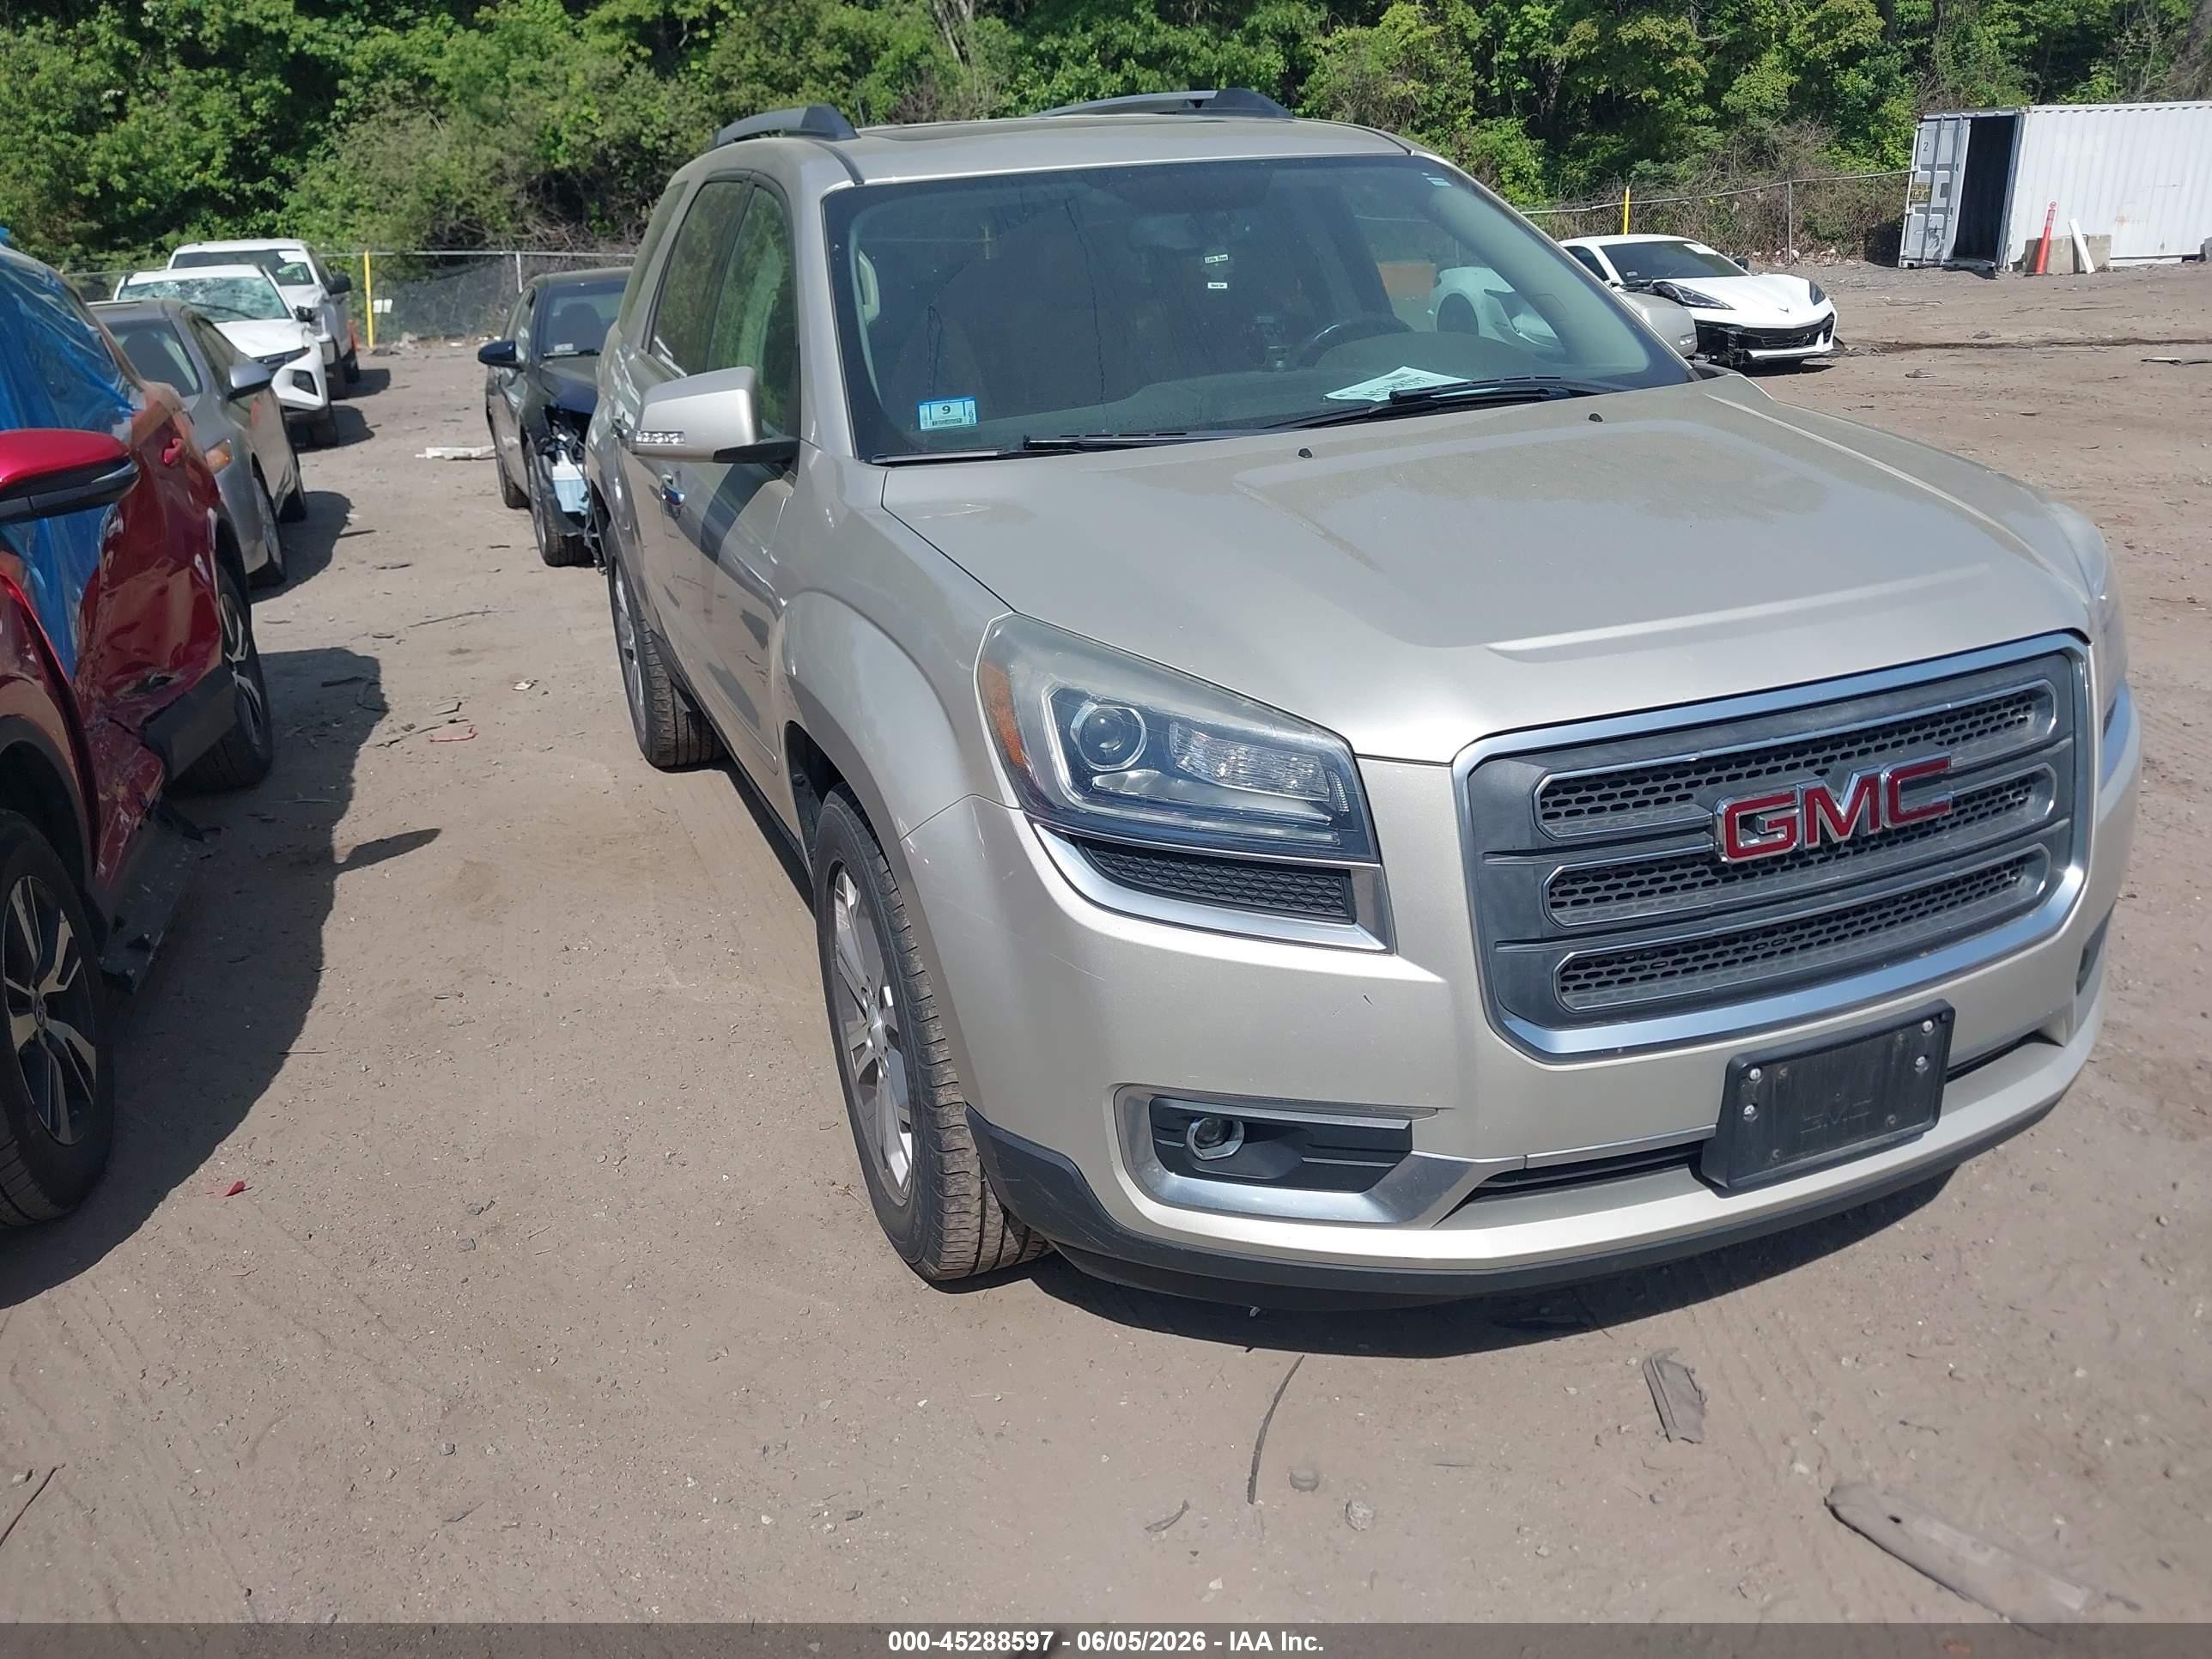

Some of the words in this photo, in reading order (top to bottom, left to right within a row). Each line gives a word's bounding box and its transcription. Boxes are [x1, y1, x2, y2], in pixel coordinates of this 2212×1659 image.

[1923, 142, 1929, 152] 2
[941, 405, 951, 415] 9
[1714, 750, 1952, 863] GMC
